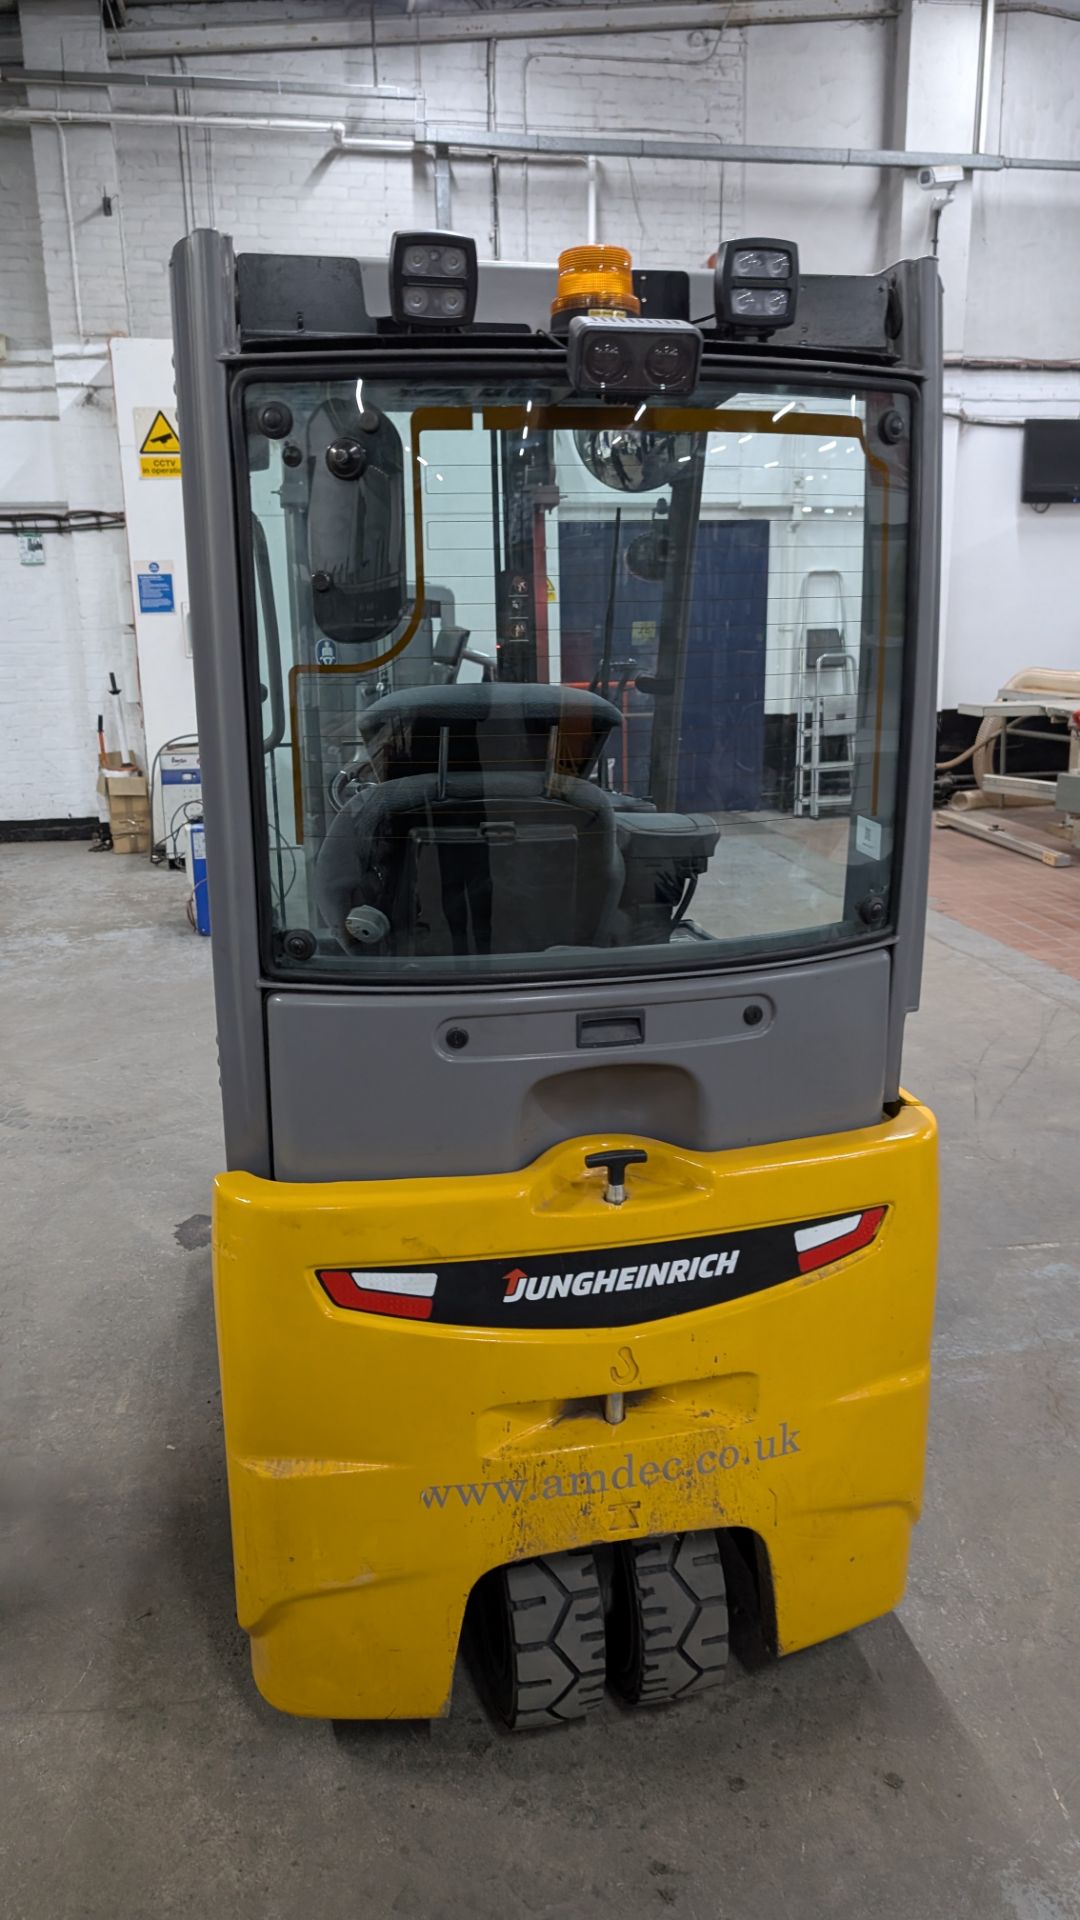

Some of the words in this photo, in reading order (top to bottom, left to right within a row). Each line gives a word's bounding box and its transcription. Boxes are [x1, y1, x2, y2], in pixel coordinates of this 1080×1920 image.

[151, 467, 181, 475] operatio
[153, 459, 176, 467] CCTV
[503, 1250, 740, 1302] JUNGHEINRICH
[420, 1422, 801, 1509] www.amdec.co.uk
